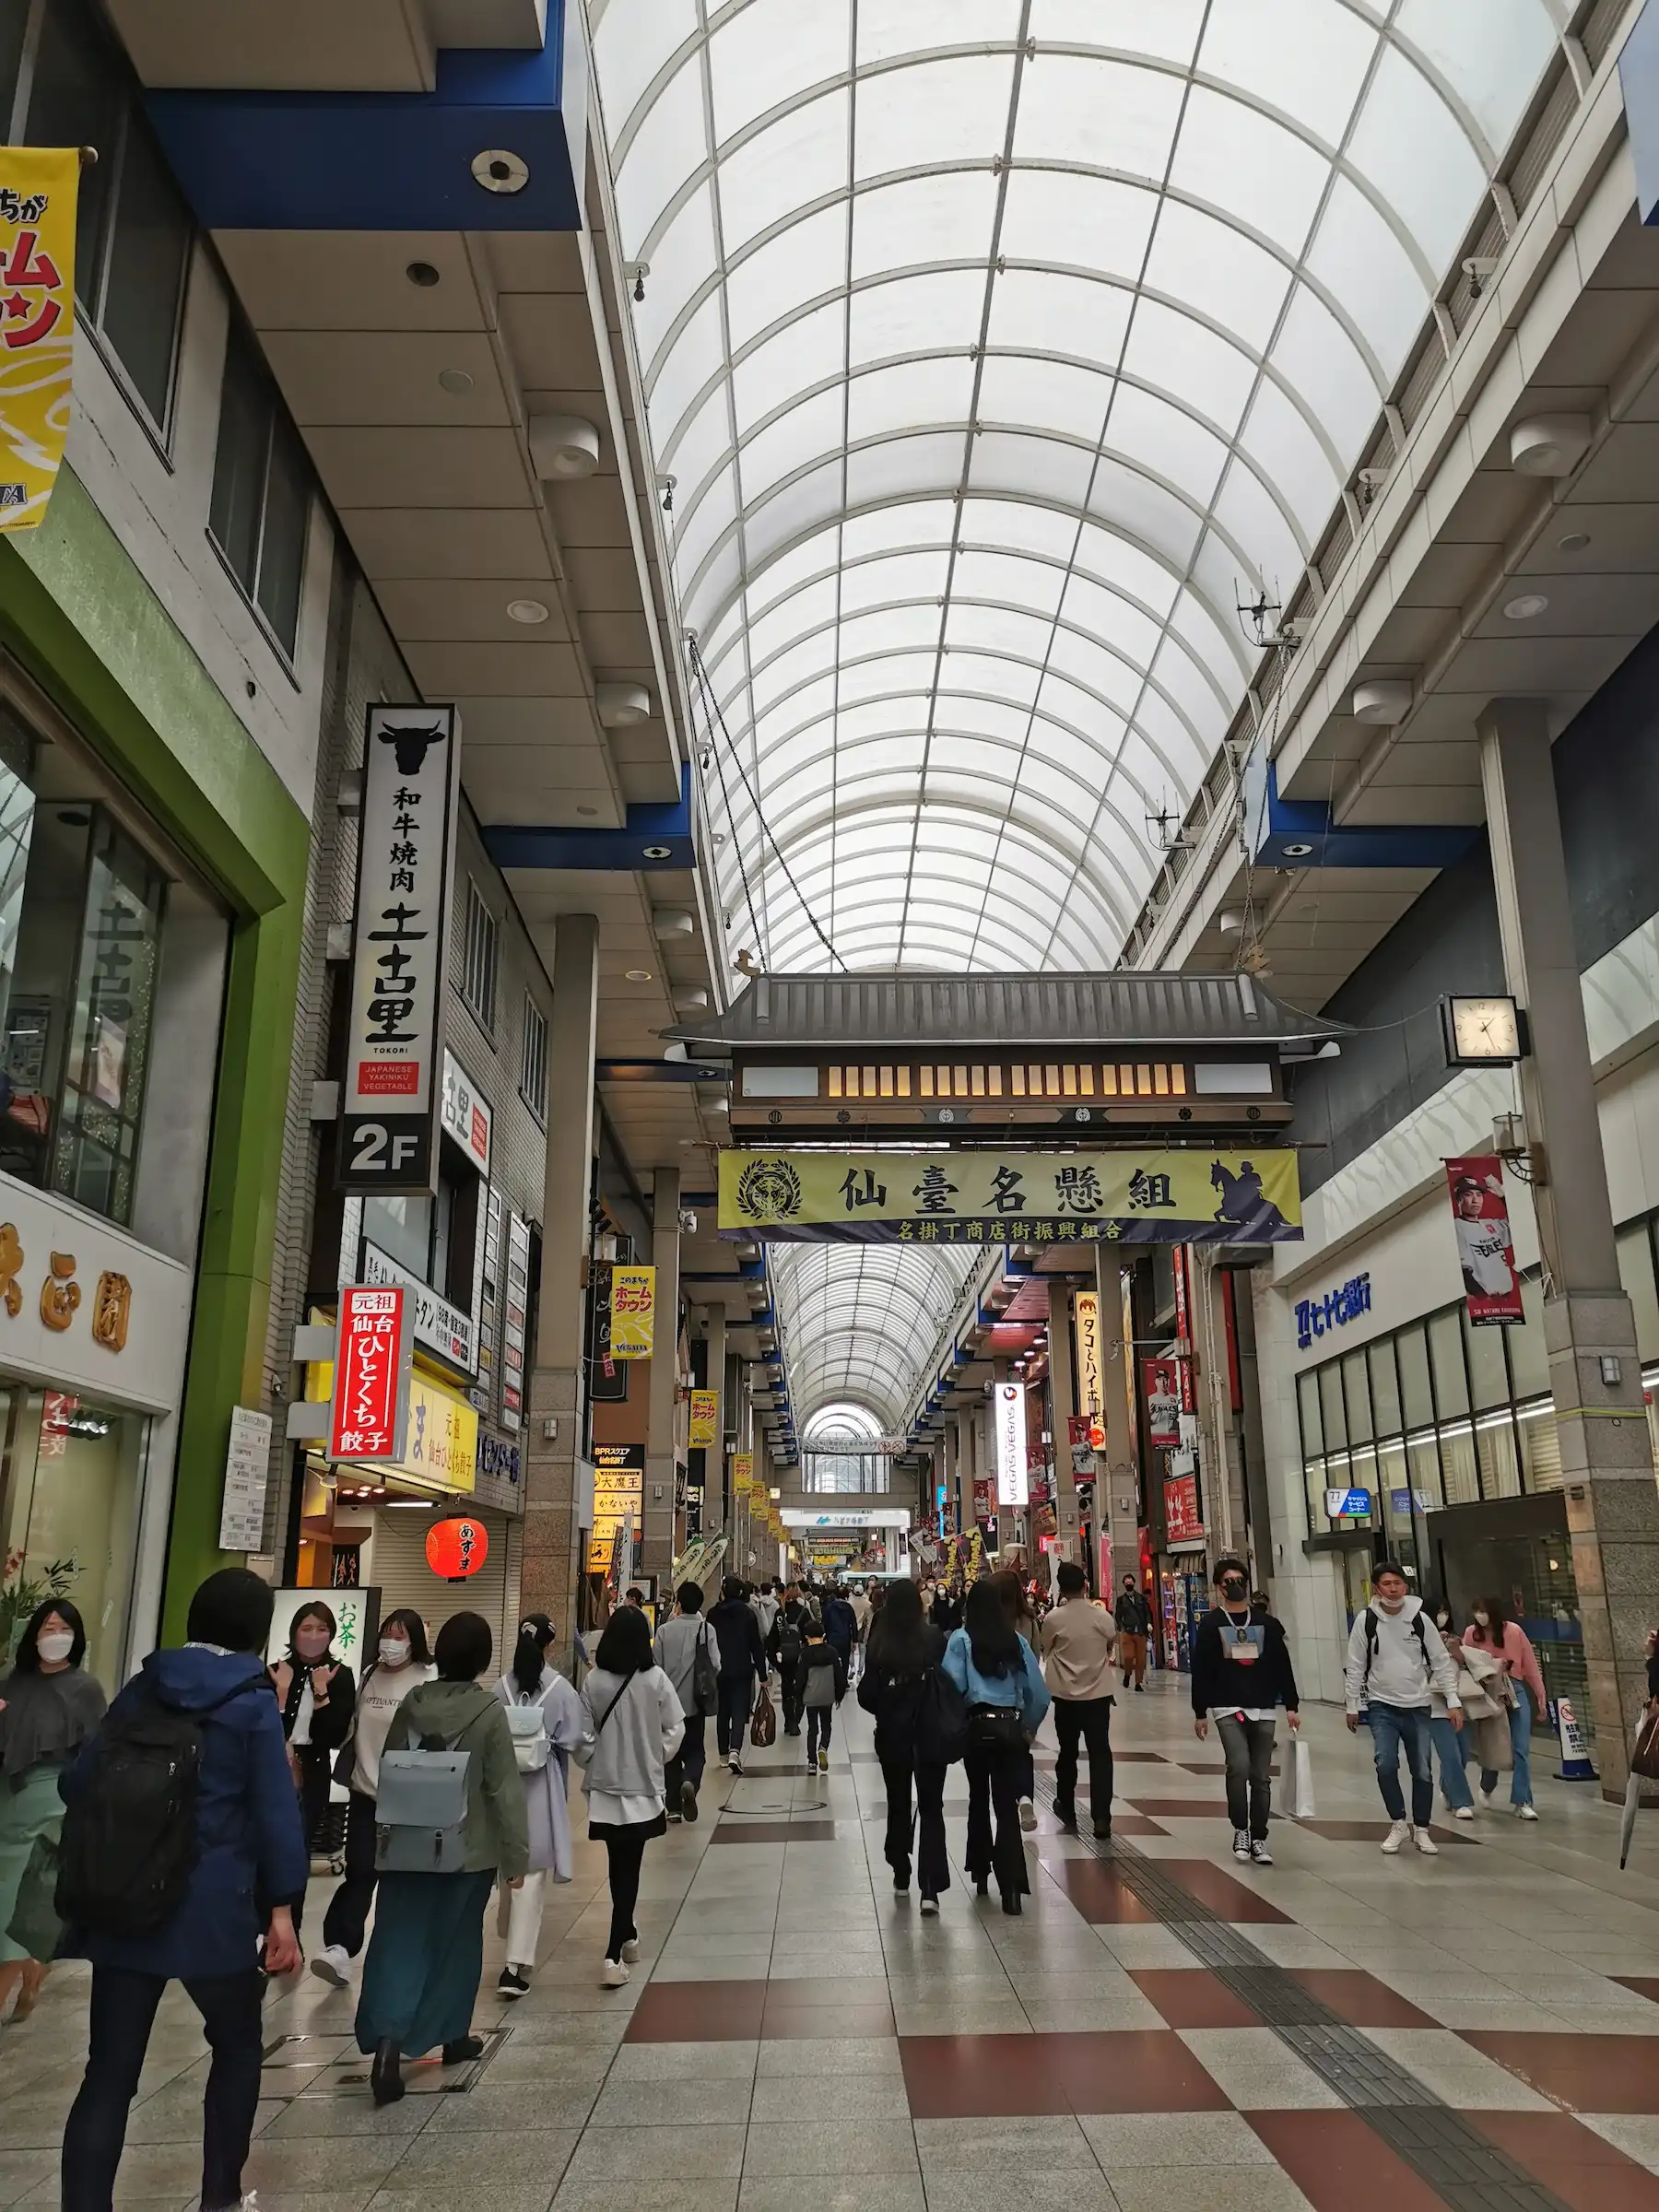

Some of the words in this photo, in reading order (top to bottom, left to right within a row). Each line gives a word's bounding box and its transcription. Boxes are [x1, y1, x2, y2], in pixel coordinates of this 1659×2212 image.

[390, 786, 421, 893] 和牛焼肉
[366, 901, 429, 1042] 土古里
[350, 1123, 419, 1170] 2F
[838, 1165, 1179, 1215] 仙臺名懸組
[896, 1219, 1124, 1241] 名掛丁商店街振興組合
[355, 1295, 394, 1310] 元祖
[616, 1287, 652, 1299] ホーム
[616, 1300, 652, 1312] タウン
[1310, 1272, 1371, 1338] 七十七銀行
[351, 1315, 394, 1333] 仙台
[353, 1335, 384, 1428] ひとくち
[692, 1403, 715, 1411] ホーム
[692, 1411, 715, 1419] タウン
[340, 1430, 388, 1453] 餃子
[429, 1439, 472, 1477] 仙台ひとくち餃子
[602, 1477, 639, 1488] 大魔王
[459, 1524, 475, 1571] あずま
